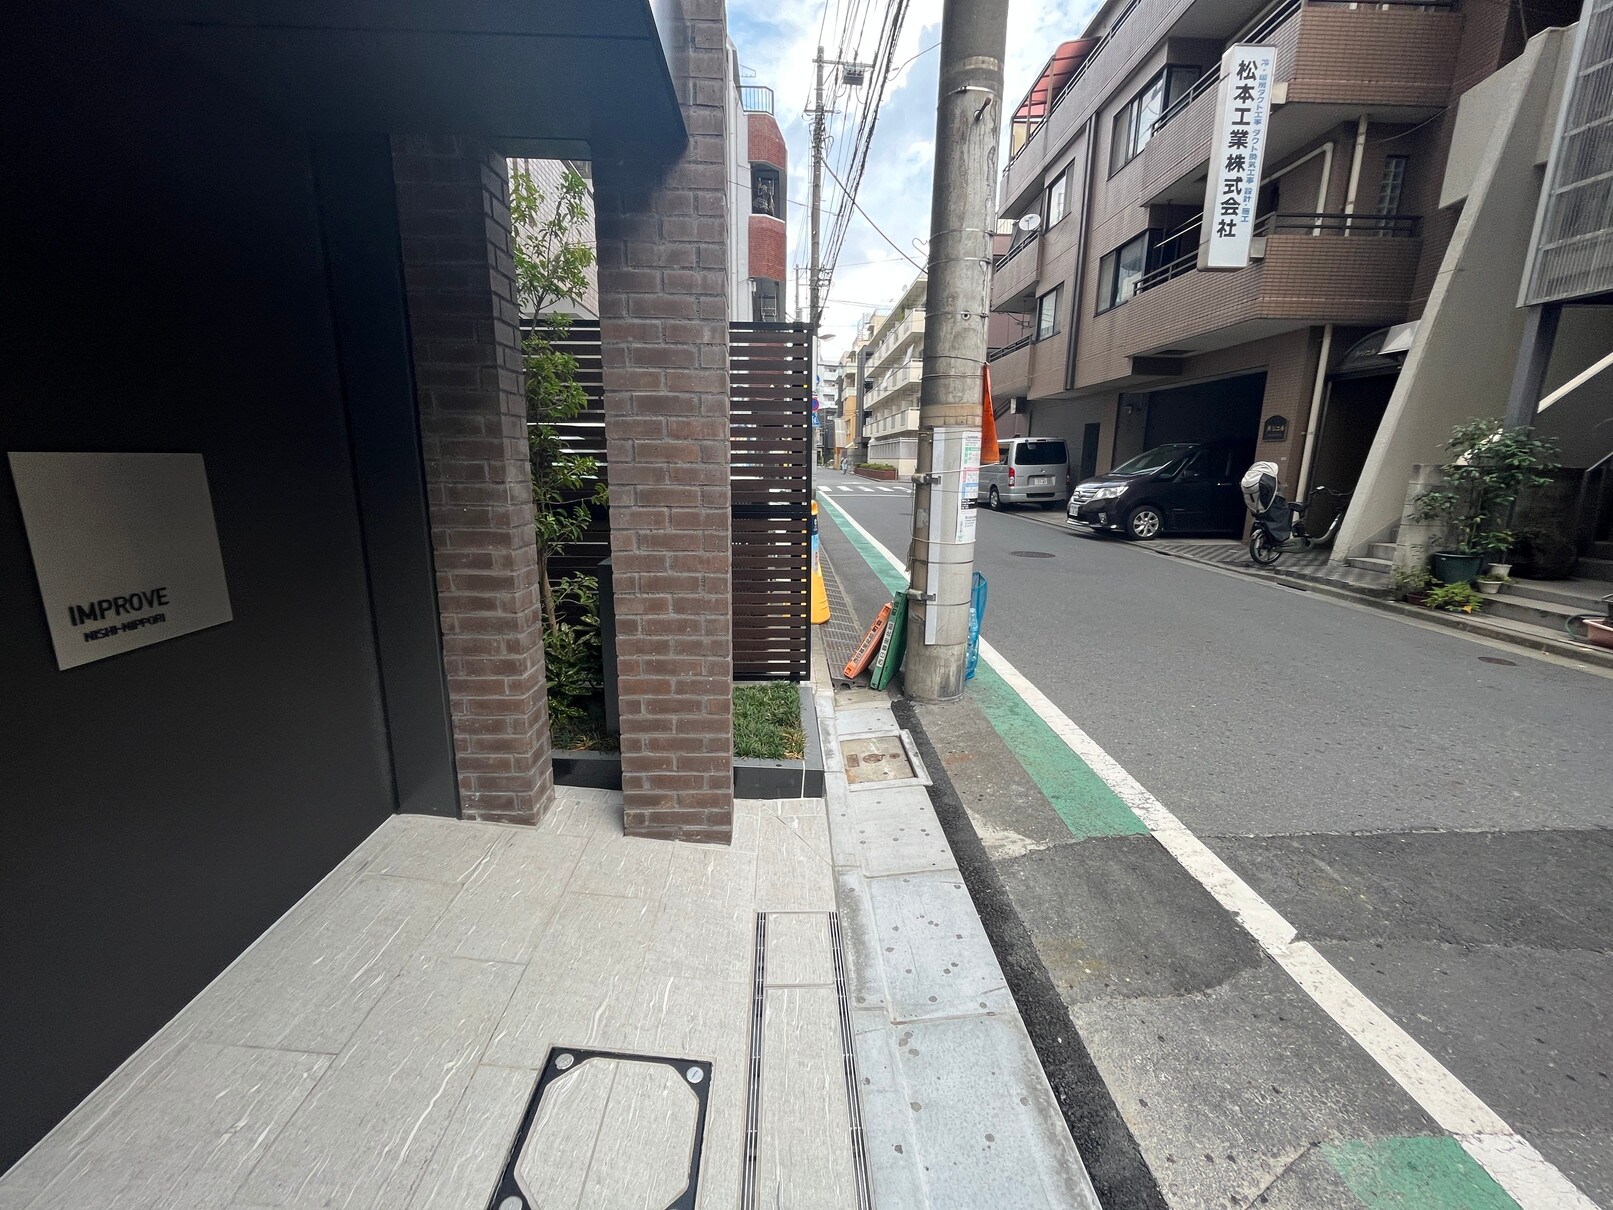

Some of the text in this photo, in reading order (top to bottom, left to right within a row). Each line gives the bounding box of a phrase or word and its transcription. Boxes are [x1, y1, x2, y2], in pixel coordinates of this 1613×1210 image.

[1217, 60, 1259, 238] 松本工業株式会社
[68, 587, 170, 627] IMPROVE
